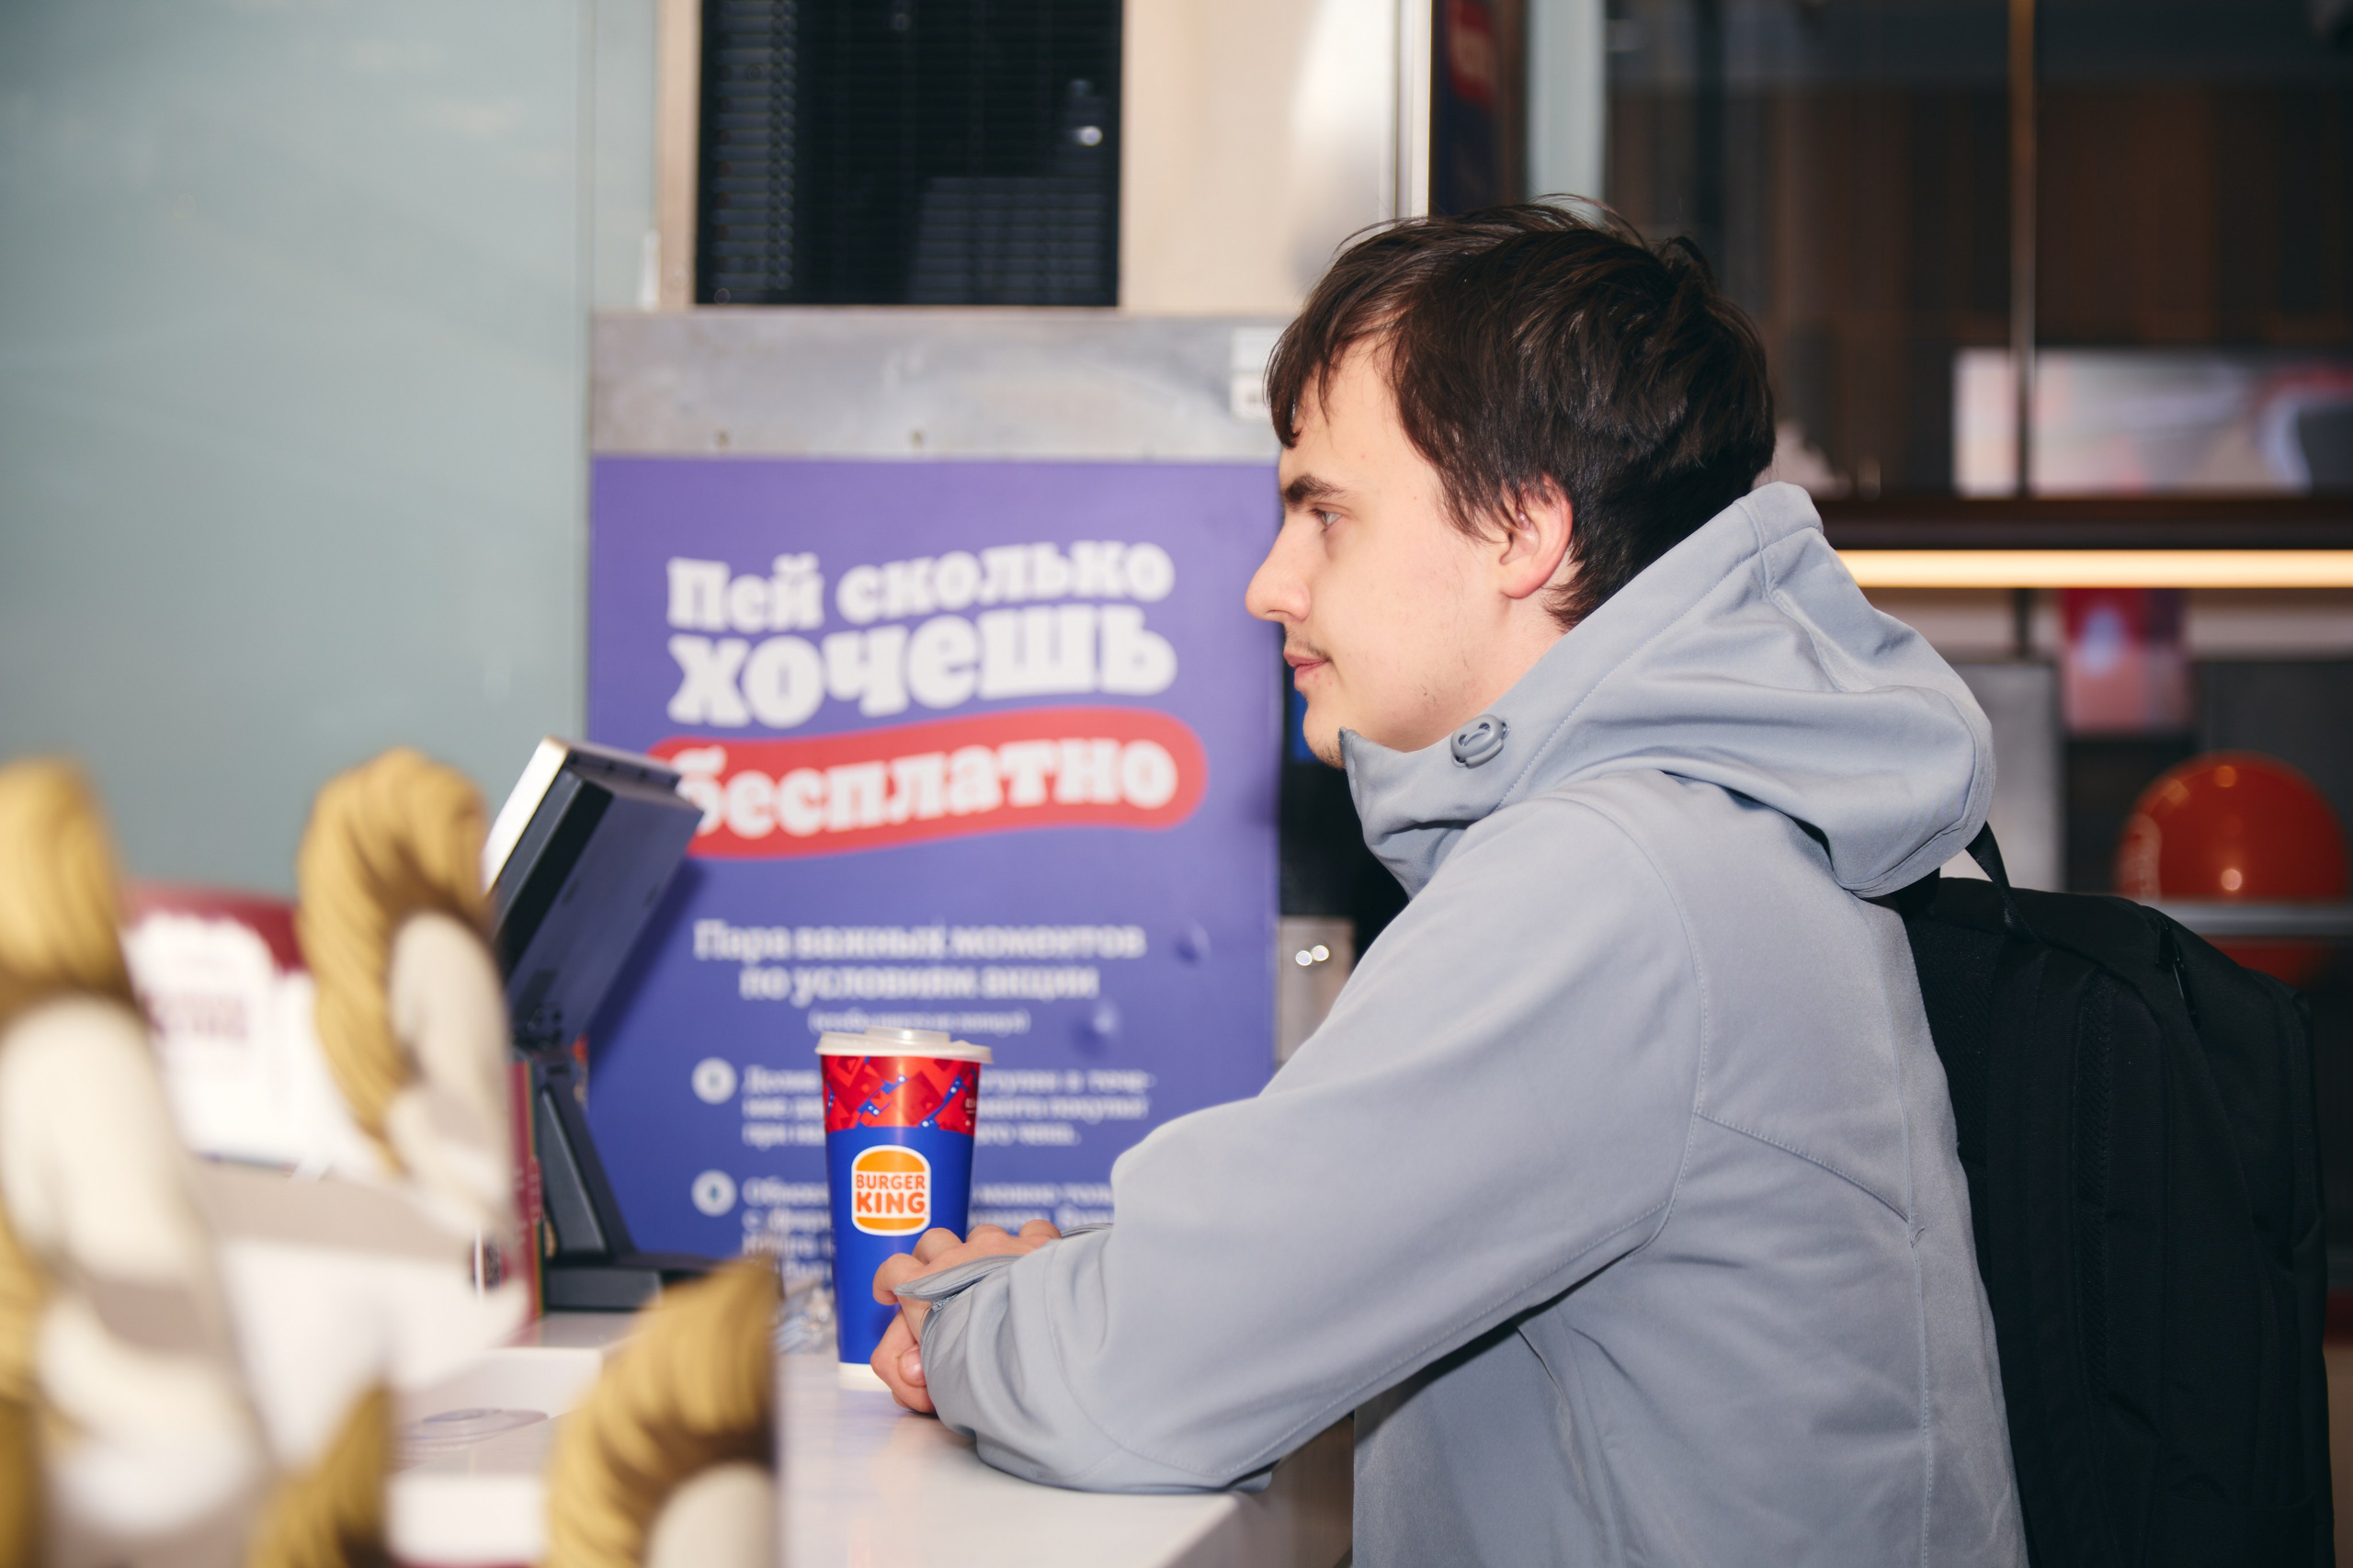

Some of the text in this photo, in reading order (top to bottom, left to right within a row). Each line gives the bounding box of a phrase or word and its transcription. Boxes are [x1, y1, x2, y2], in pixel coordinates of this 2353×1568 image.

[668, 540, 1175, 632] Пей сколько
[667, 605, 1177, 728] хочешь
[675, 740, 1177, 837] бесплатно
[694, 920, 1147, 967] Пара важных моментов
[740, 966, 1099, 1008] по условиям акции
[856, 1173, 926, 1190] BURGER
[856, 1191, 926, 1214] KING
